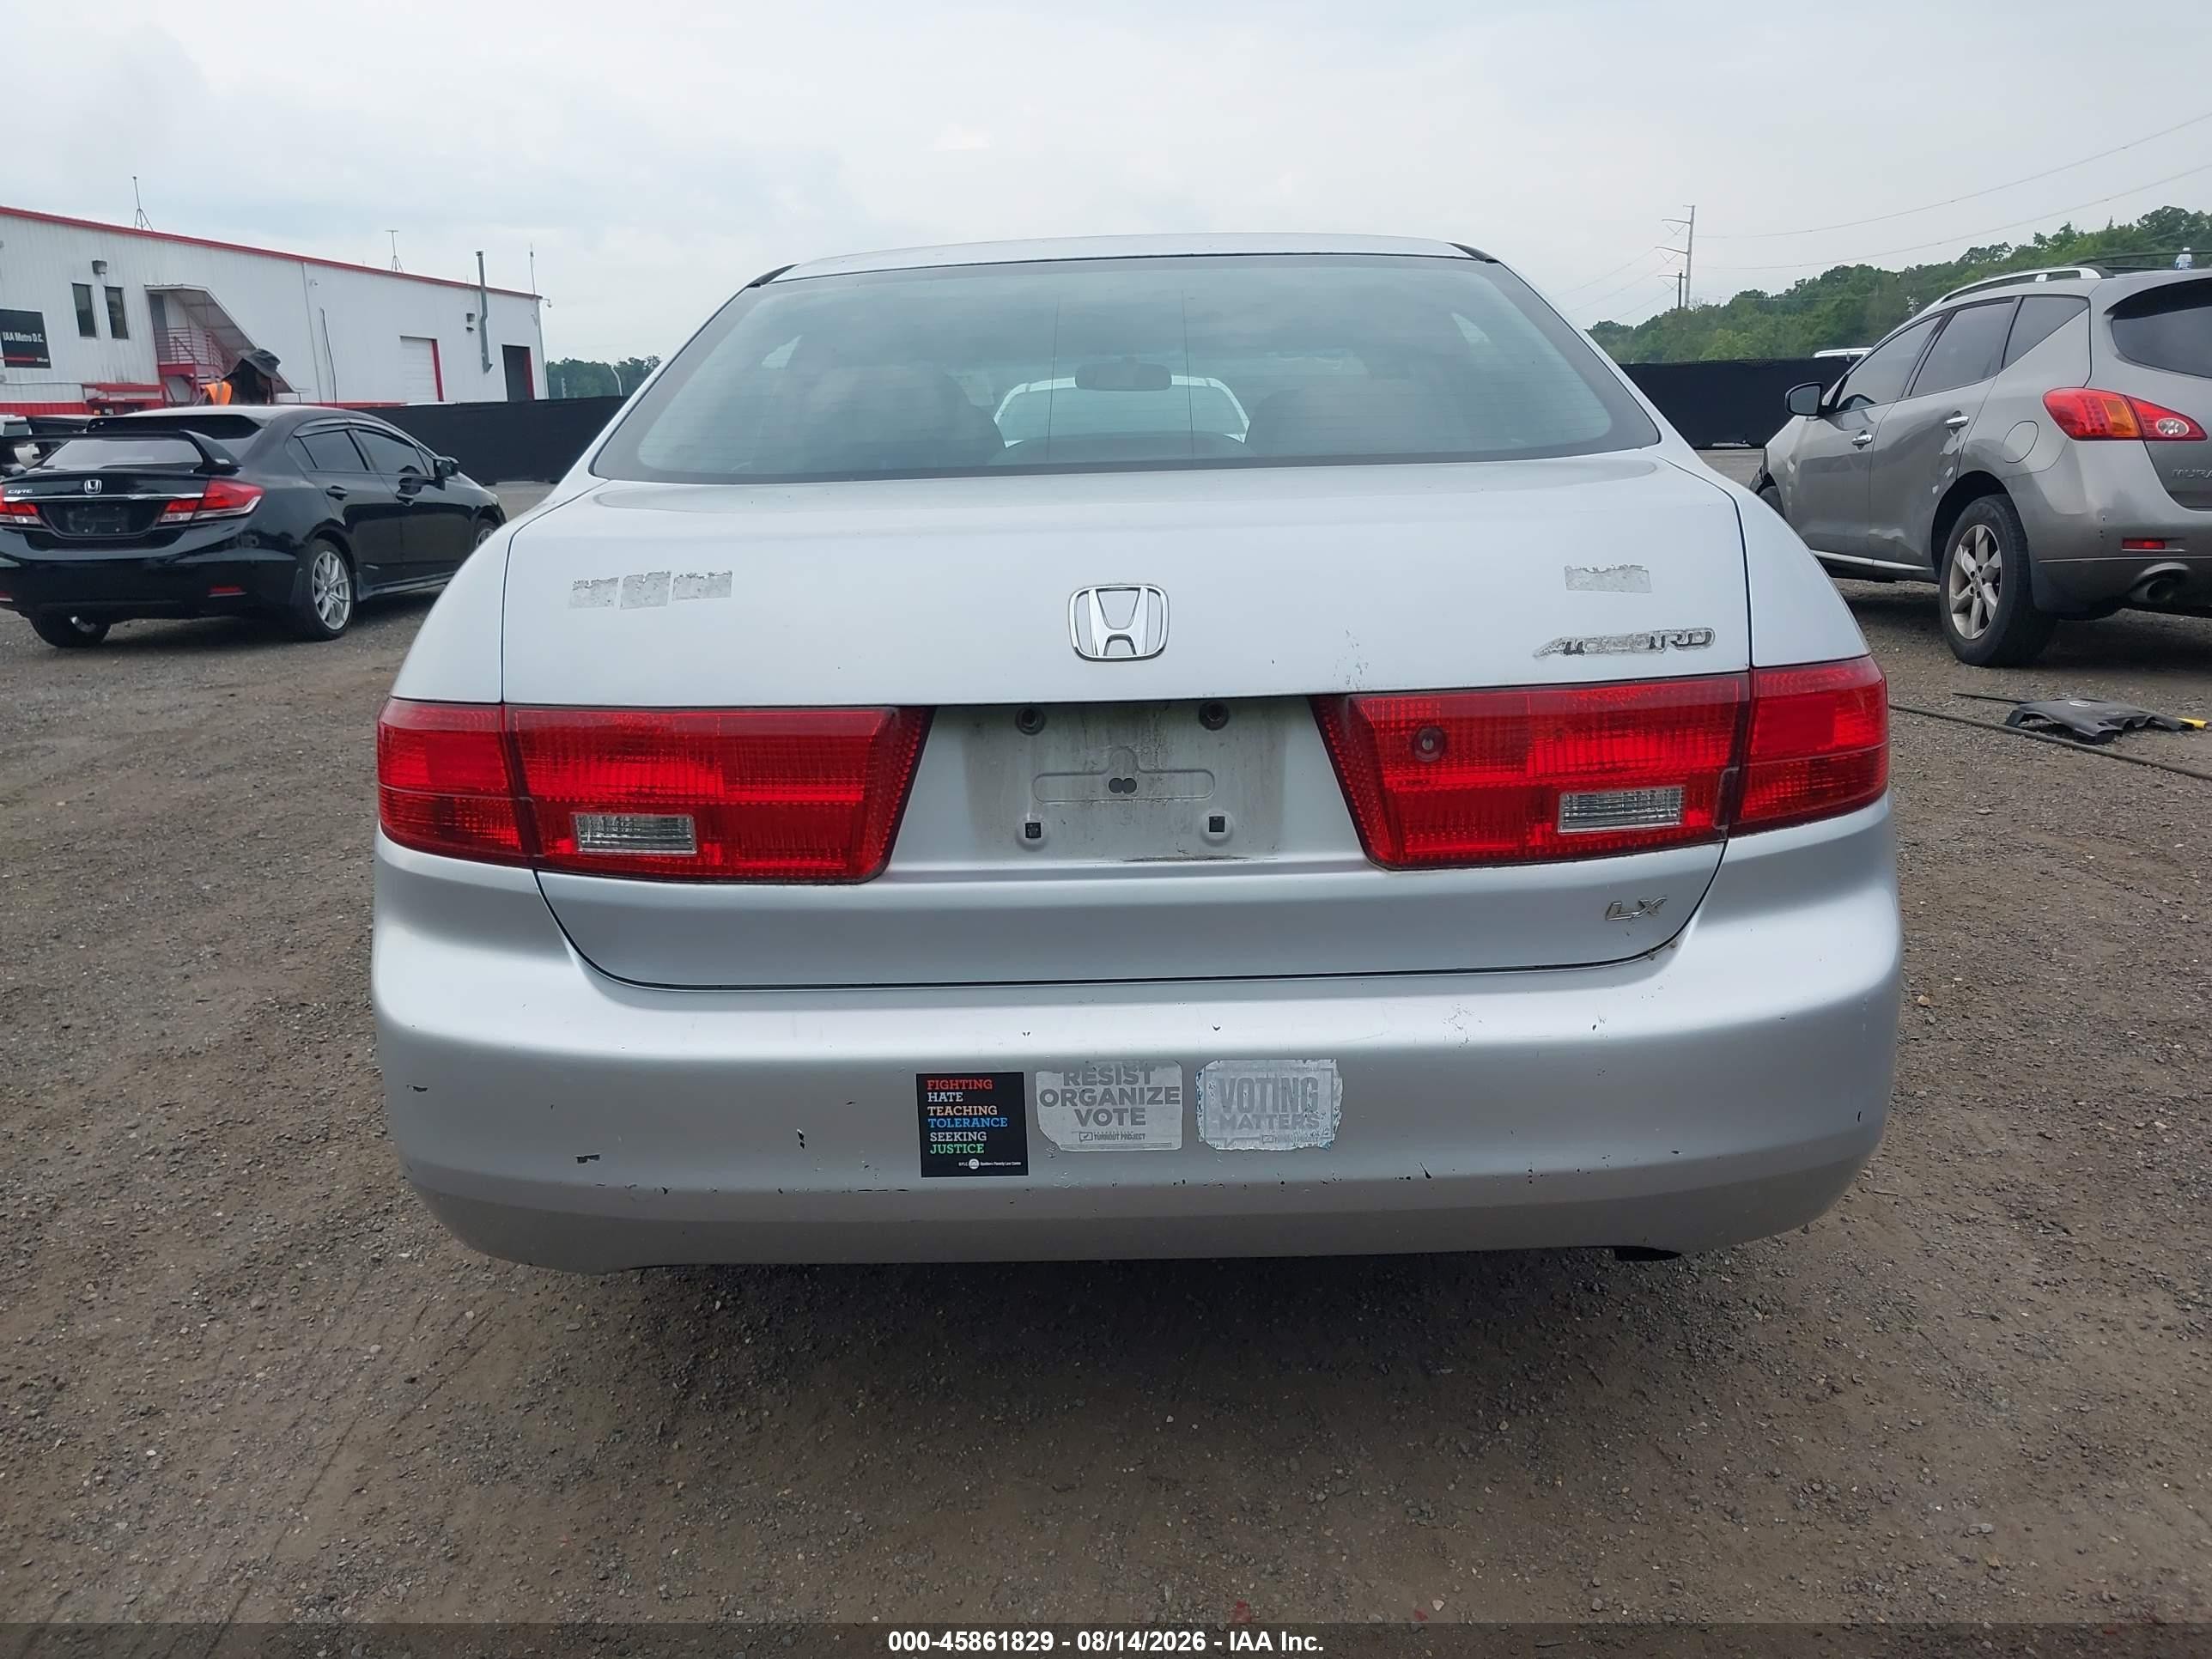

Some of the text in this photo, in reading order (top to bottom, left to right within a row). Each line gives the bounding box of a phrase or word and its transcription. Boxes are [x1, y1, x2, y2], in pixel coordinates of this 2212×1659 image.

[1606, 896, 1668, 921] LX
[1063, 1064, 1153, 1085] RESIST
[927, 1079, 993, 1091] FIGHTING
[927, 1091, 963, 1103] HATE
[1039, 1086, 1181, 1107] ORGANIZE
[1217, 1077, 1319, 1114] VOTING
[927, 1105, 998, 1116] TEACHING
[1074, 1108, 1146, 1127] VOTE
[927, 1117, 1008, 1128] TOLERANCE
[1219, 1114, 1320, 1130] MATTERS
[930, 1131, 988, 1142] SEEKING
[930, 1144, 985, 1154] JUSTICE
